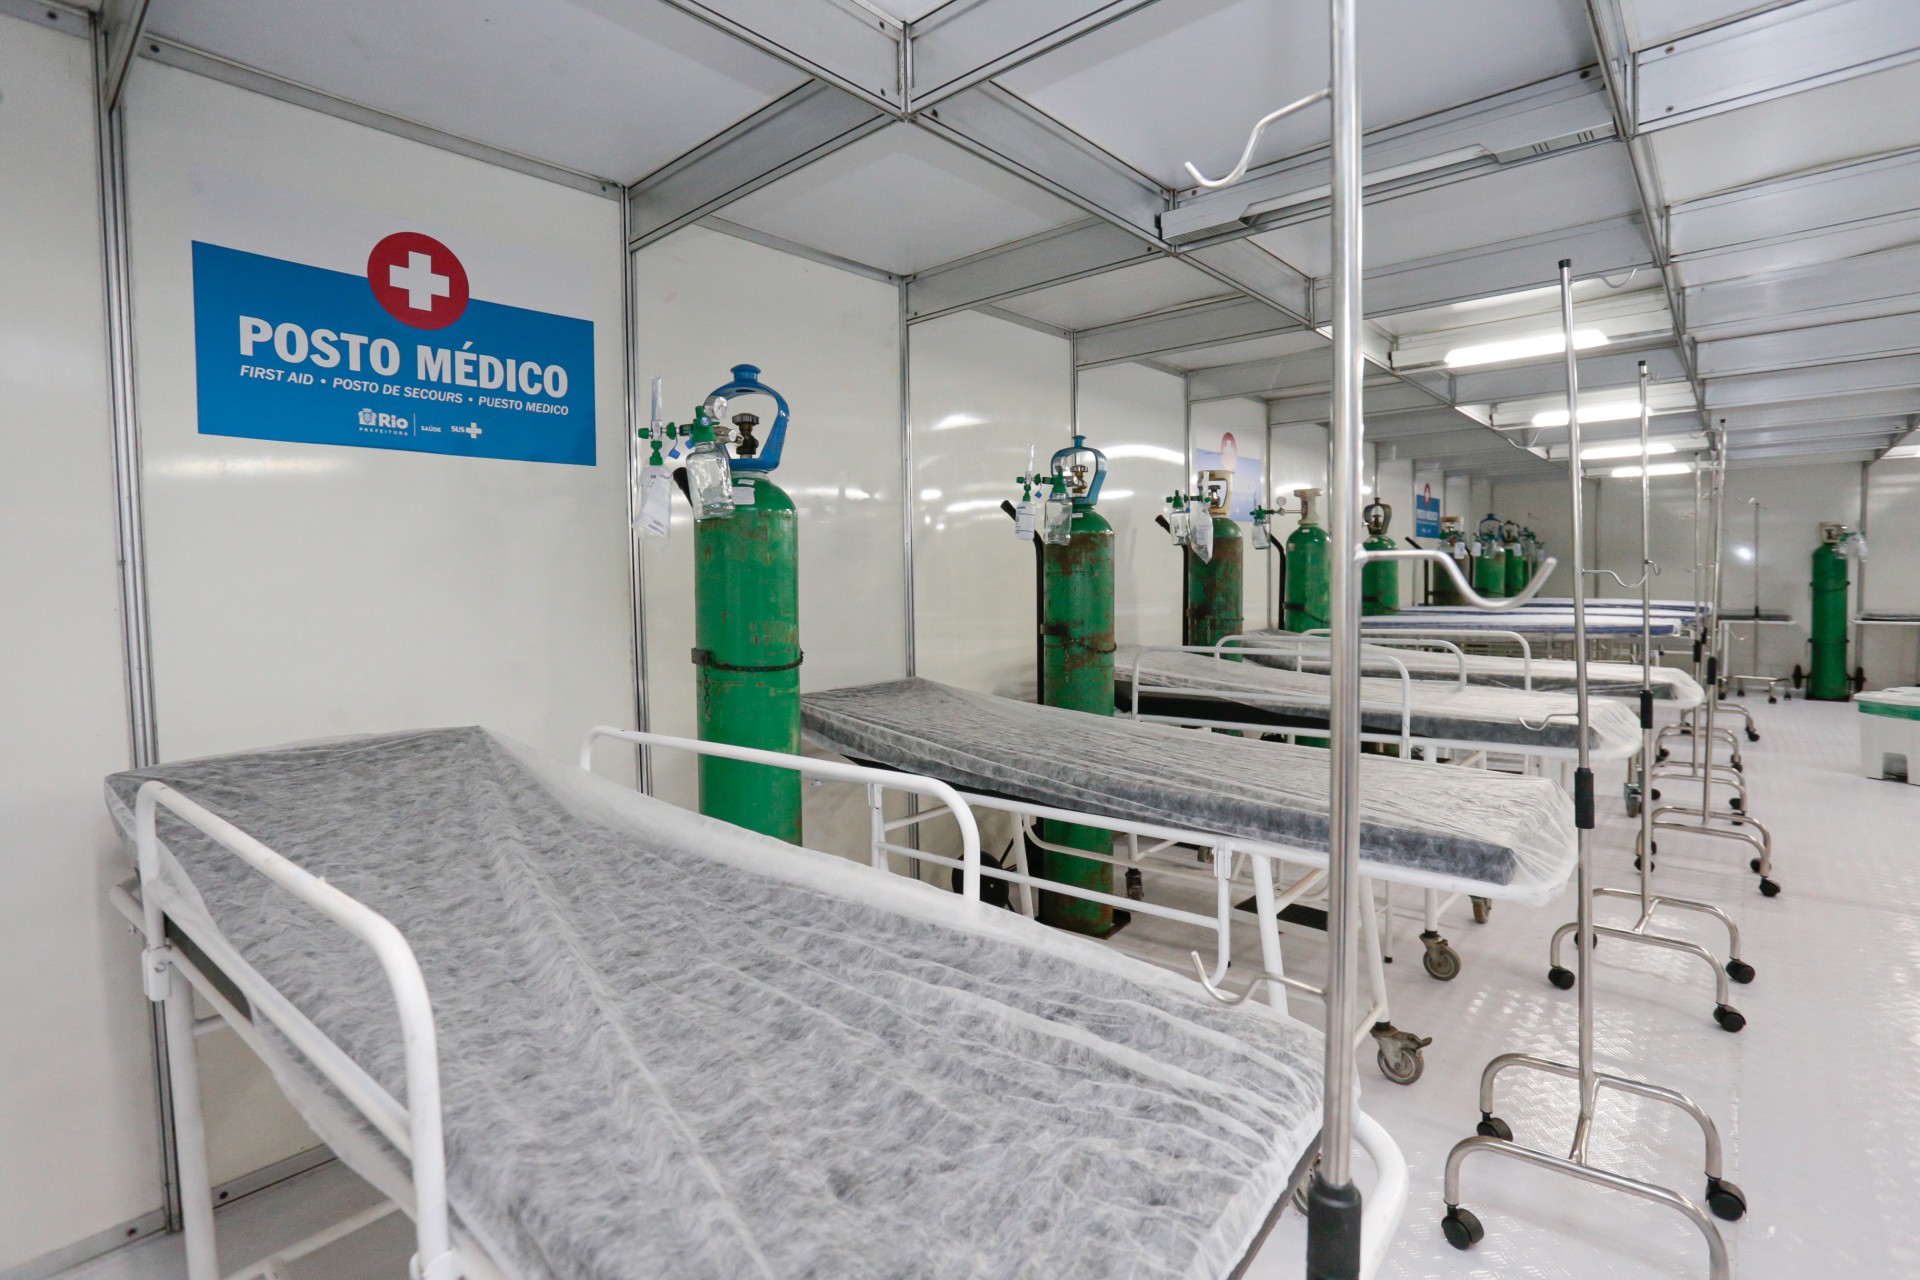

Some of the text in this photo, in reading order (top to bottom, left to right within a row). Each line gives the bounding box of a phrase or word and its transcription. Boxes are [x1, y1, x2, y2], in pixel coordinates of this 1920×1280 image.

[239, 315, 569, 398] POSTO MÉDICO
[240, 364, 569, 416] FIRST AID POSTO DE SECOURS PUESTO MEDICO
[358, 427, 409, 436] PREFEITURA
[378, 412, 409, 429] Rio
